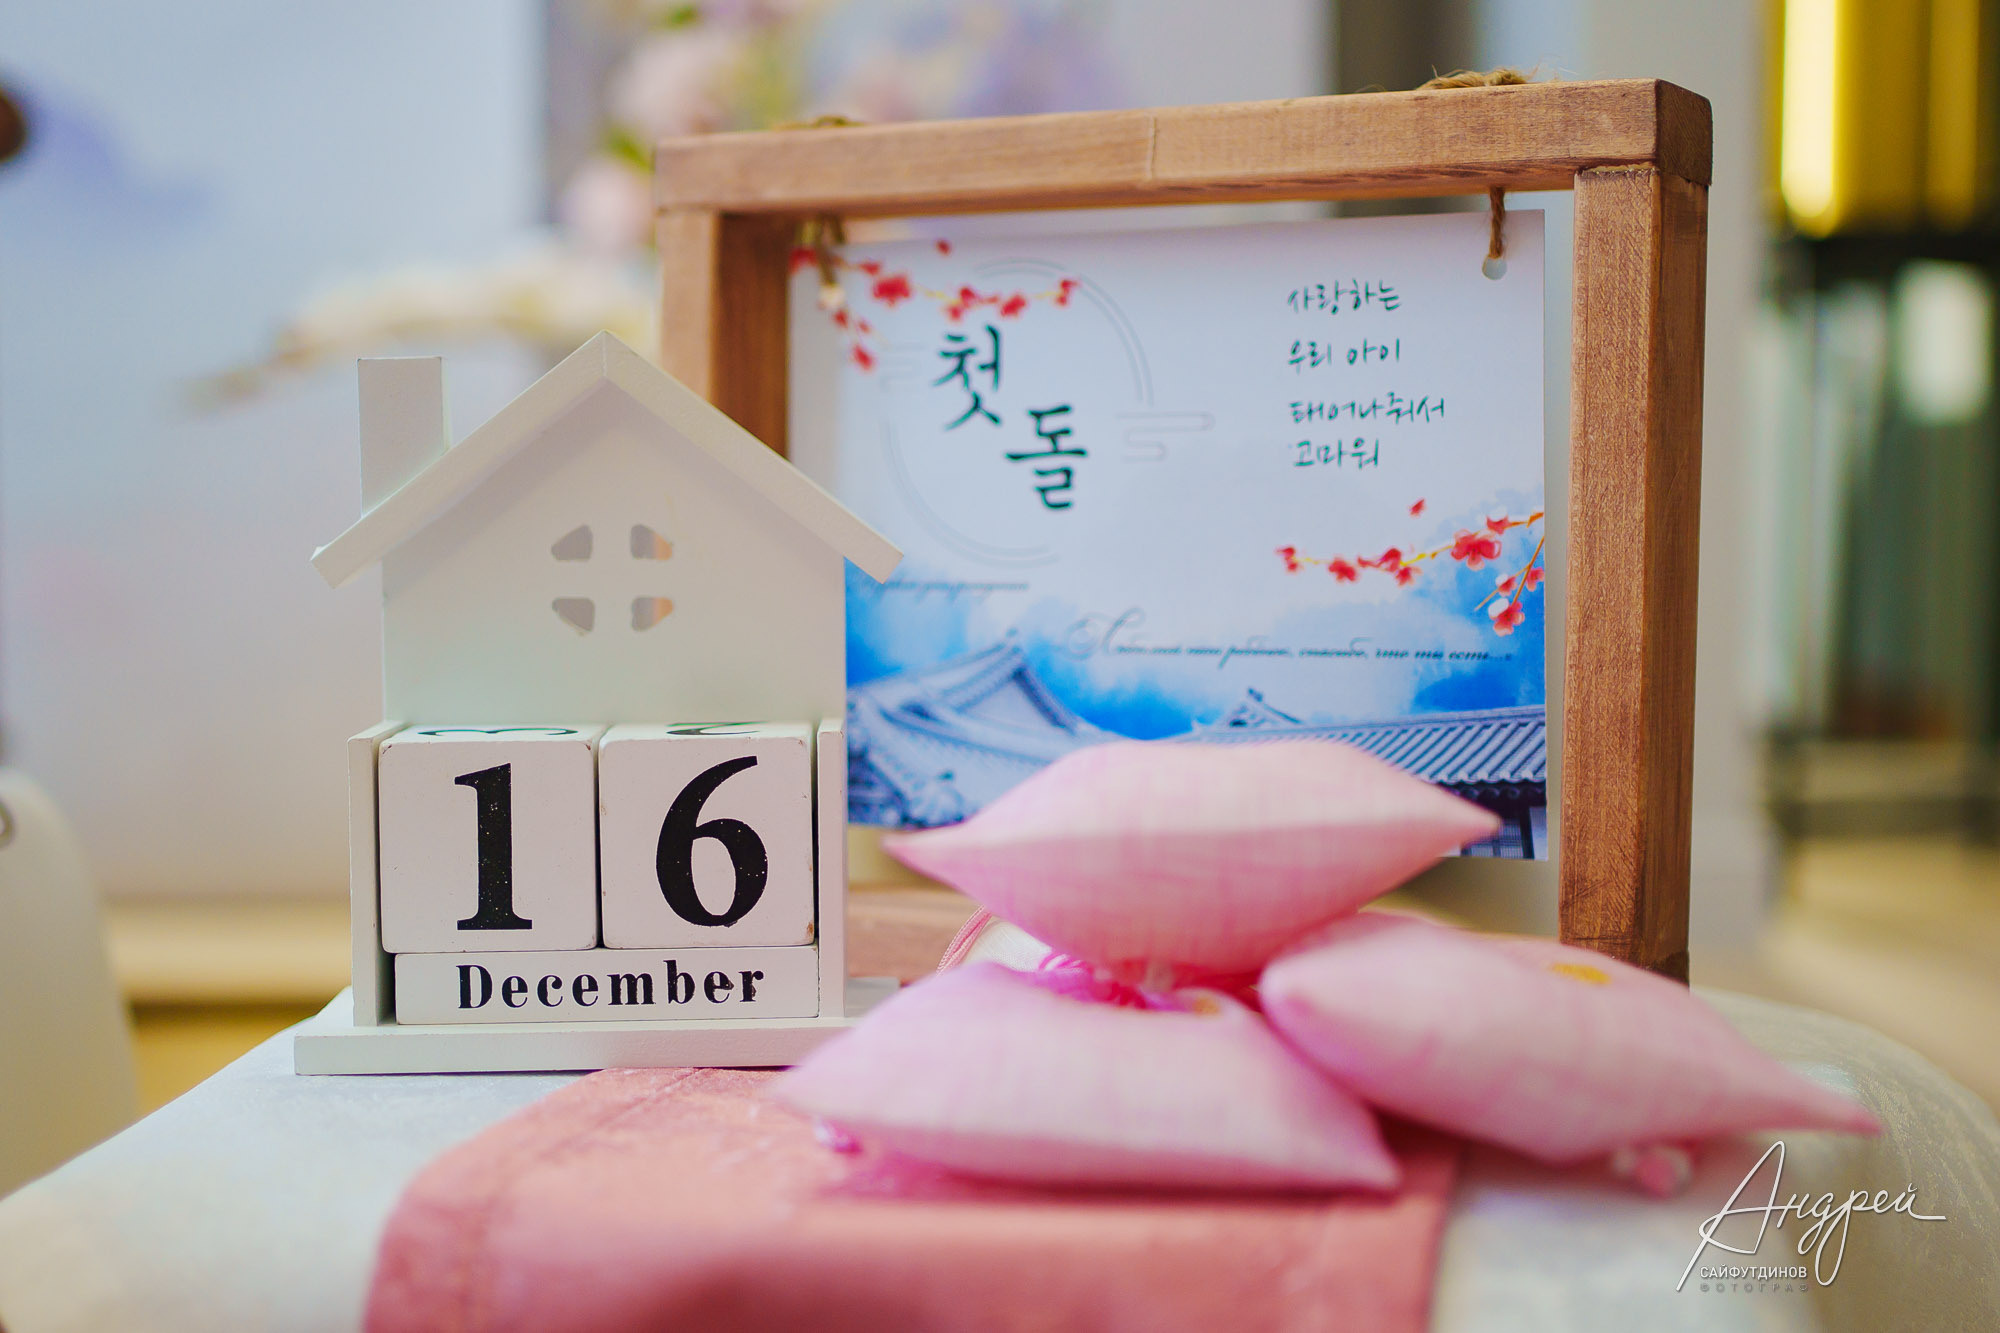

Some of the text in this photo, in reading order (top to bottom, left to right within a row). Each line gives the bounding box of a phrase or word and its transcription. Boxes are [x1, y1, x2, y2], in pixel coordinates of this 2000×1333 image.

[1287, 278, 1401, 316] 사랑하는
[1287, 337, 1401, 374] 우리 아이
[933, 323, 1089, 511] 첫 돌
[1288, 391, 1446, 425] 태어나줘서
[1293, 437, 1380, 470] 고마워
[455, 959, 764, 1009] December
